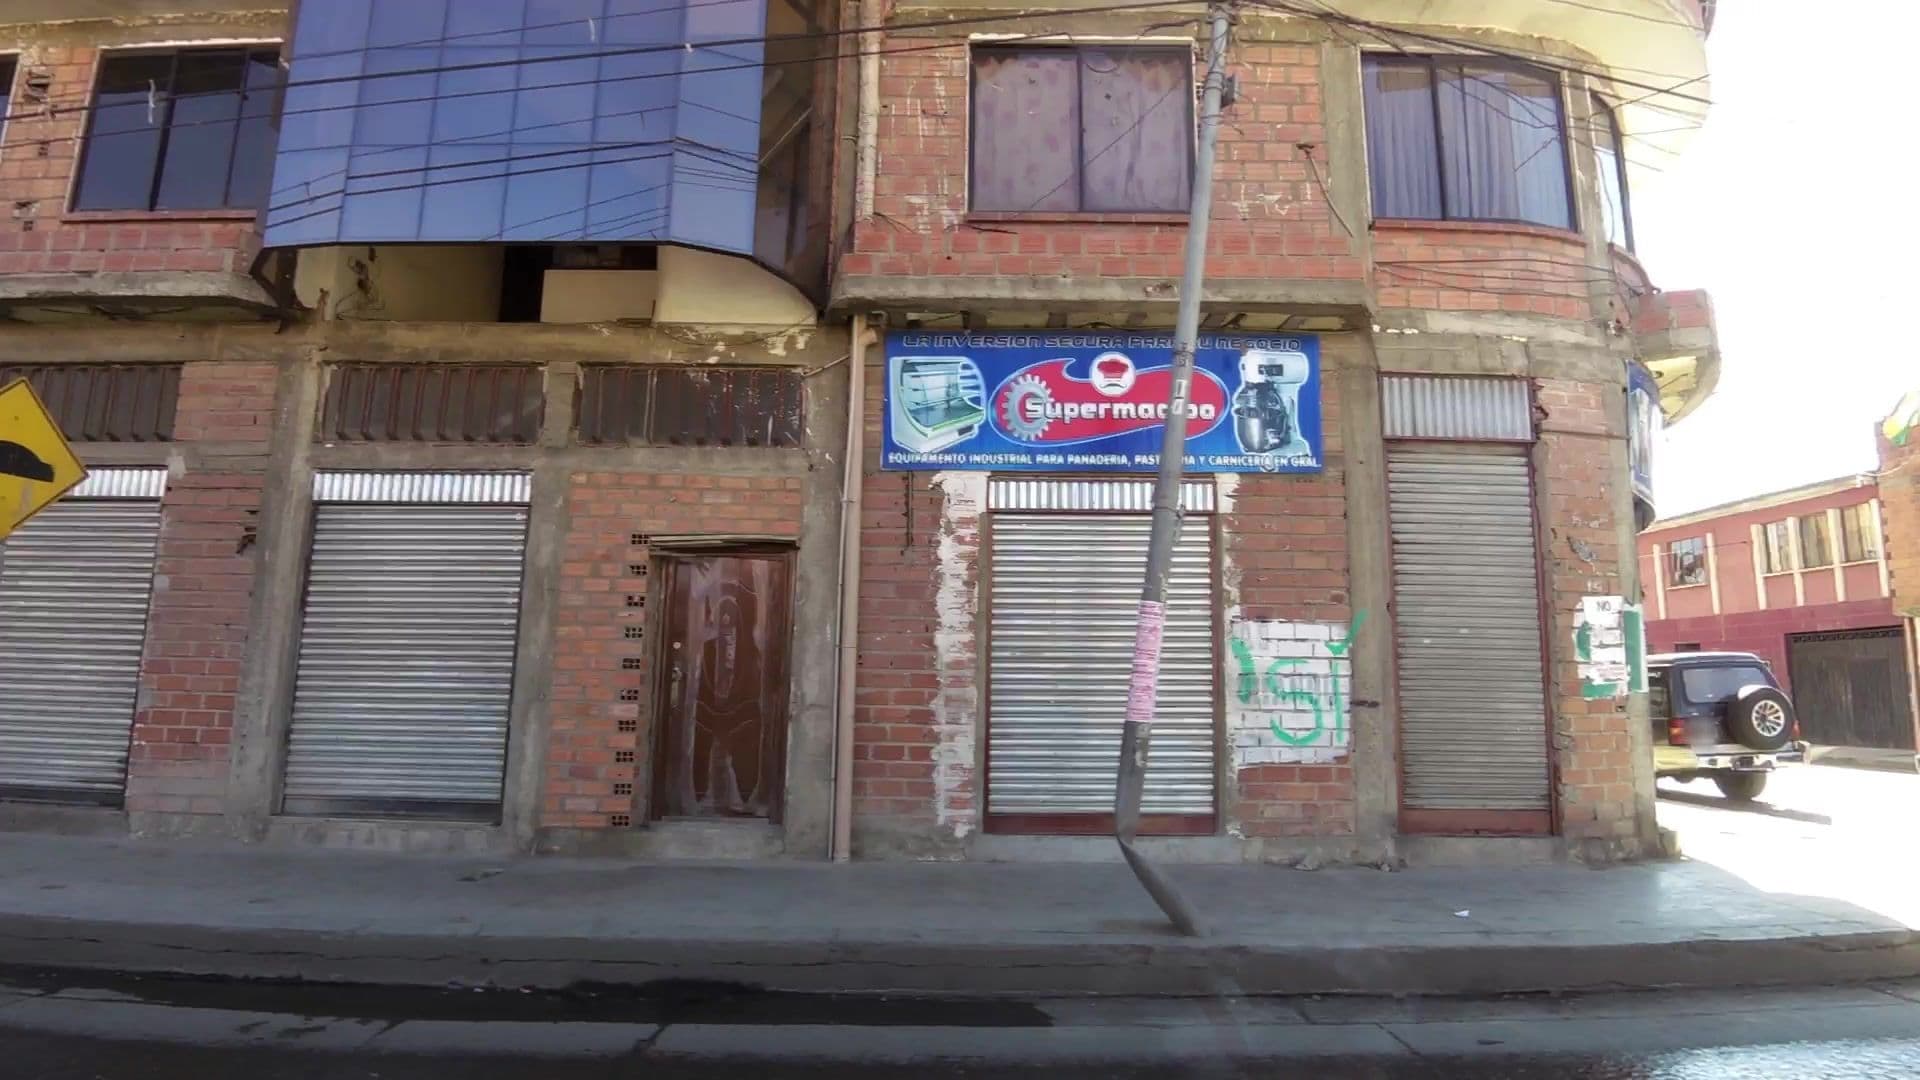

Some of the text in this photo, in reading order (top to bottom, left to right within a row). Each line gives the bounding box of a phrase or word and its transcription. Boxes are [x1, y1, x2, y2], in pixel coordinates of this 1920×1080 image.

[903, 335, 932, 348] LA
[934, 335, 1041, 348] INVERSION
[1044, 335, 1124, 349] SEGURA
[888, 453, 966, 465] EQUIPAMENTO
[969, 453, 1032, 465] INDUSTRIAL
[1036, 453, 1064, 465] PARA
[1199, 455, 1206, 466] Y
[1274, 456, 1288, 467] EN
